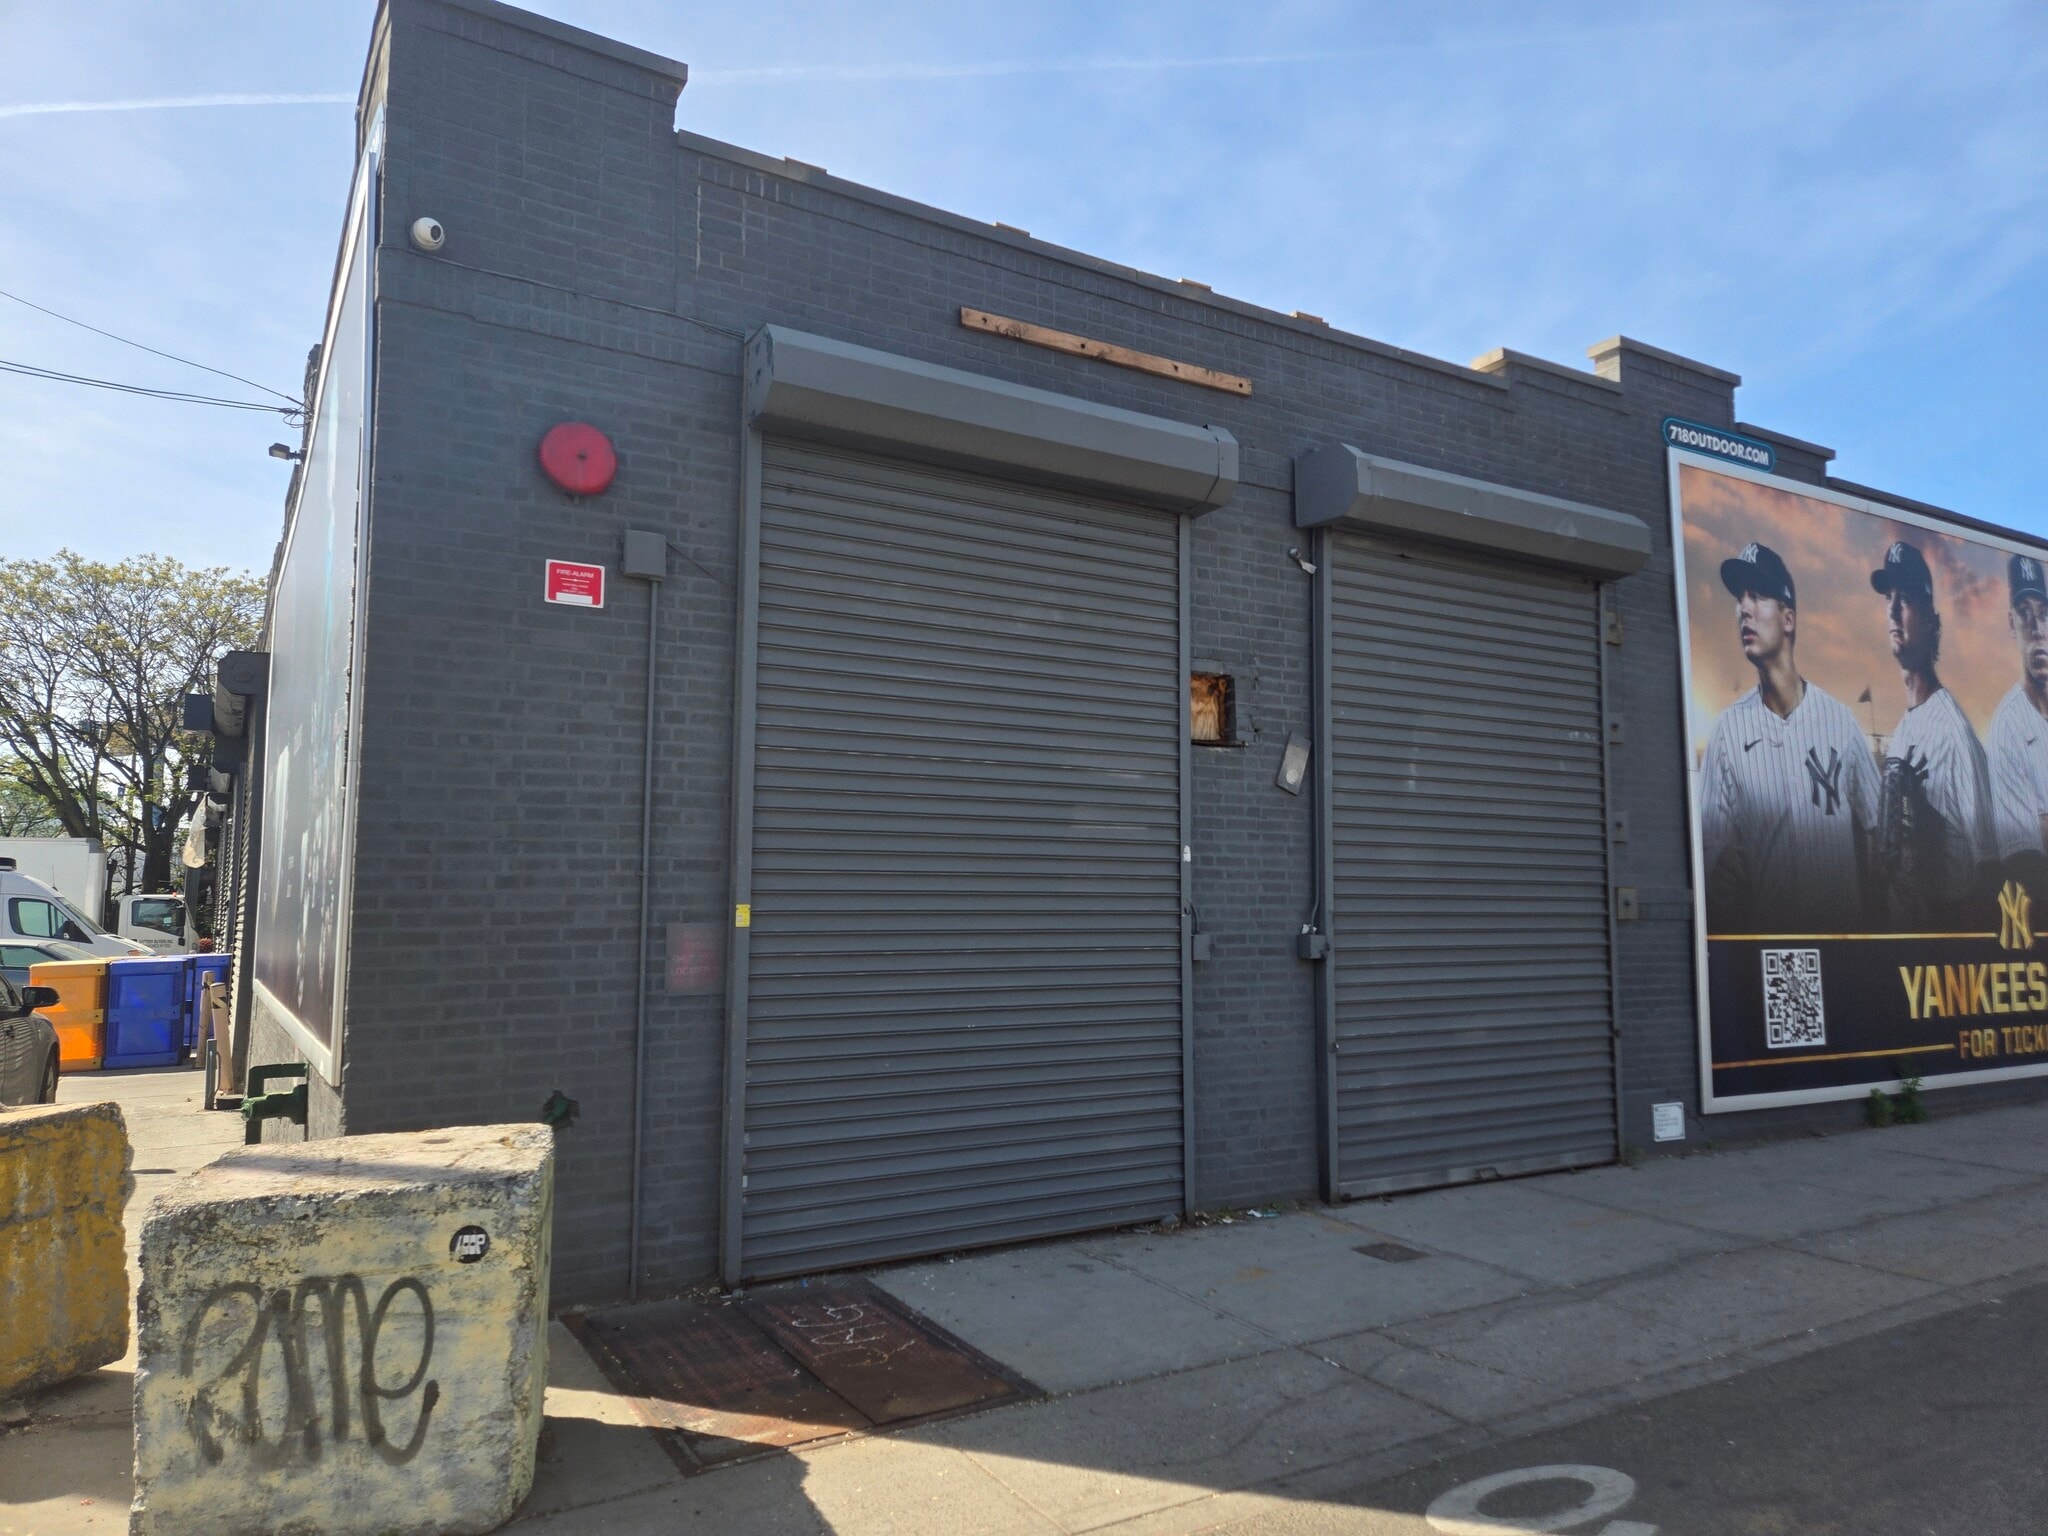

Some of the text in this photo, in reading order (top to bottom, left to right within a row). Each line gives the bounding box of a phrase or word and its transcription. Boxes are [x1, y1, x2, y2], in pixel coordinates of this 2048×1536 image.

[1669, 425, 1769, 465] 718OUTDOOR.COM
[1898, 962, 2048, 1019] YANKEES
[1959, 1025, 2048, 1058] FOR TICK
